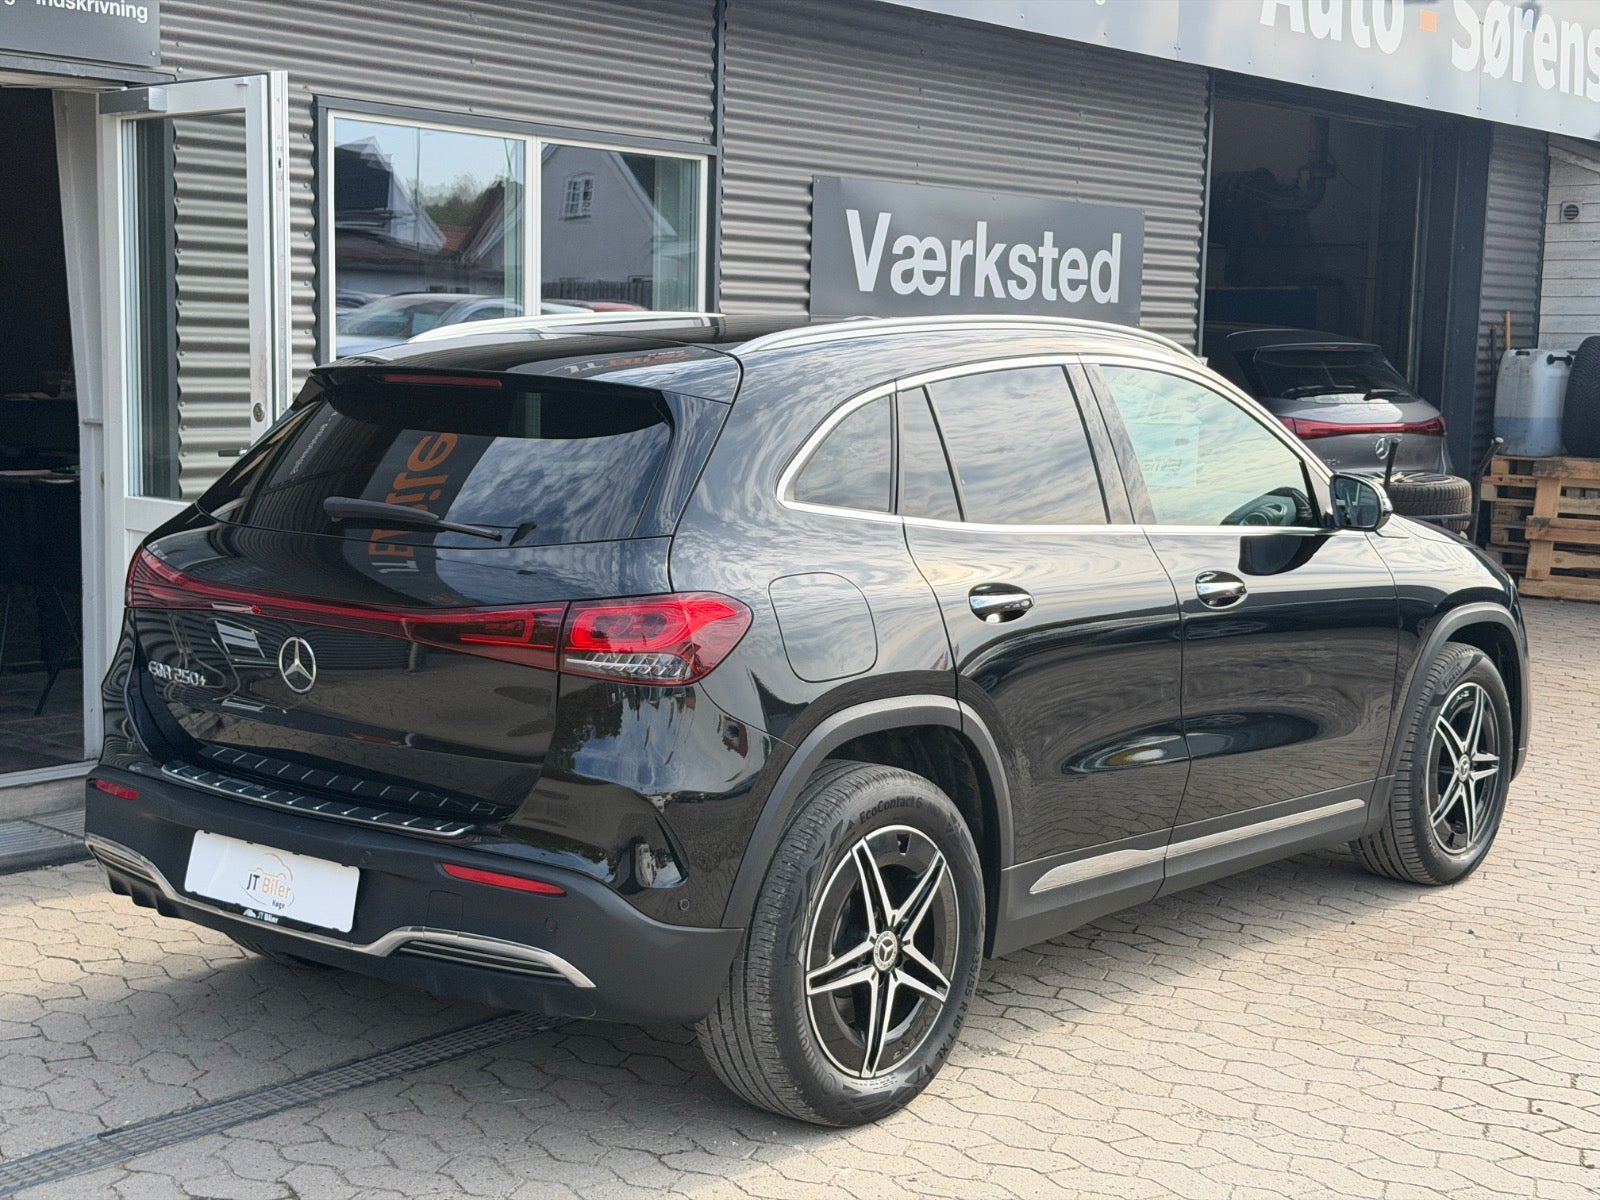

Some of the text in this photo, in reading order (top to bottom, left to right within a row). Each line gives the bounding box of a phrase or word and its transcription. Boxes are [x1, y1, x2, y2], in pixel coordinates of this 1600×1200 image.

[36, 0, 148, 23] ndskrivning
[845, 209, 1122, 304] Værksted
[173, 667, 206, 686] 250+
[246, 873, 292, 899] JT Biler
